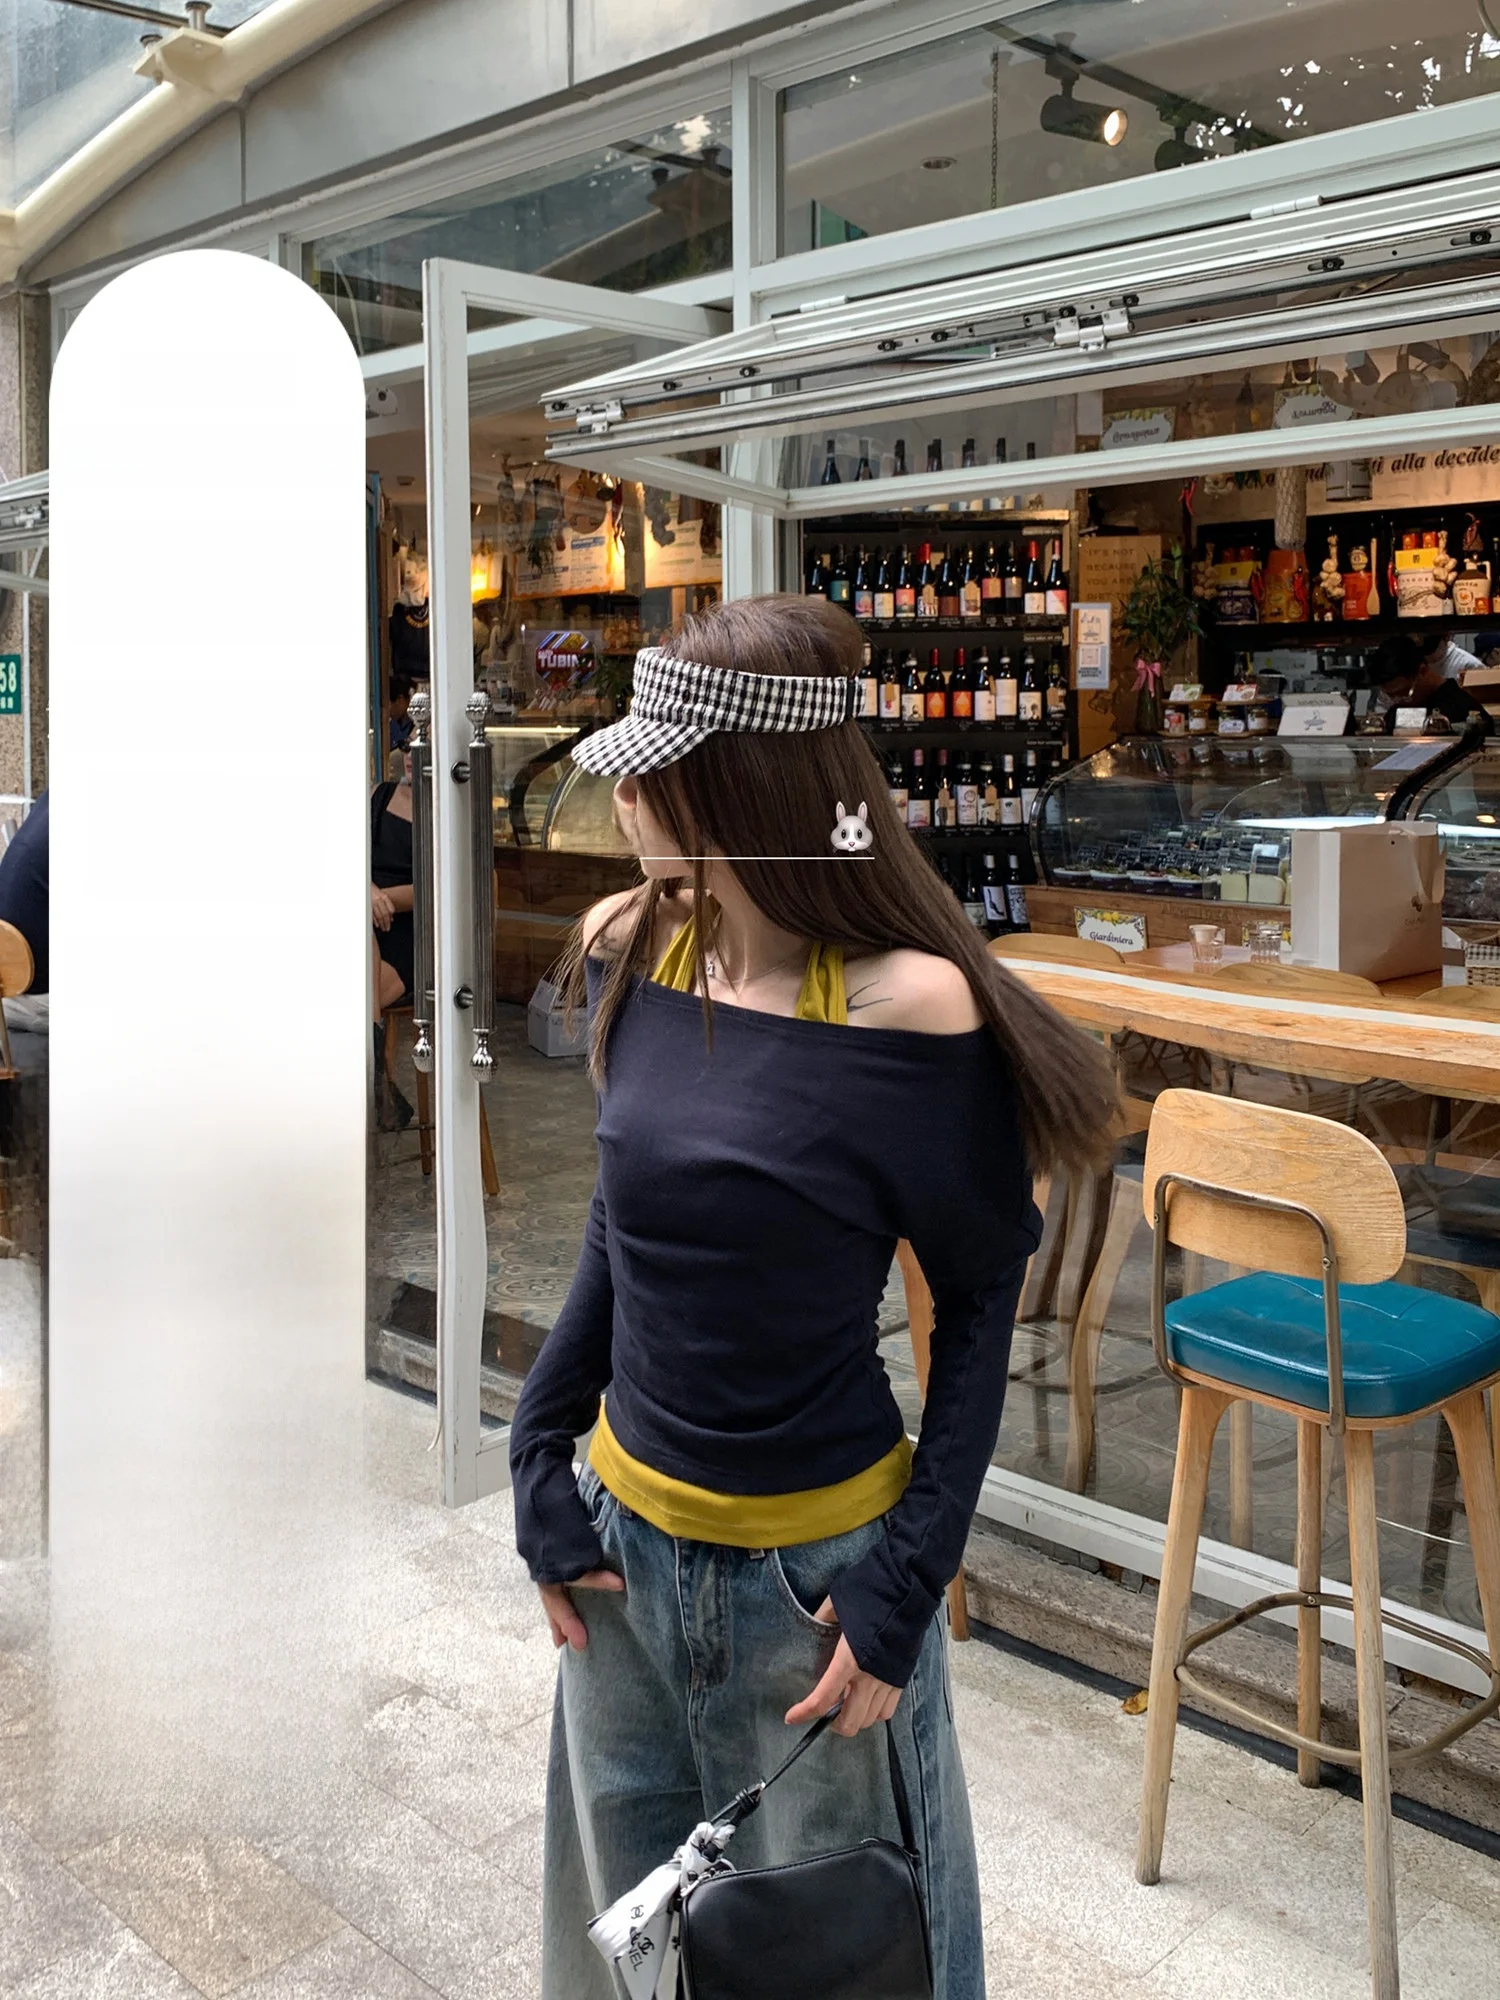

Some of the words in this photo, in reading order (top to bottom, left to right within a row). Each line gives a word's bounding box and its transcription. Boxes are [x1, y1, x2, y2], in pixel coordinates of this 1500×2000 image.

[1391, 453, 1426, 473] alla
[1086, 563, 1136, 571] BECAUSE
[0, 661, 17, 693] 58
[1089, 931, 1134, 945] Giardiniera
